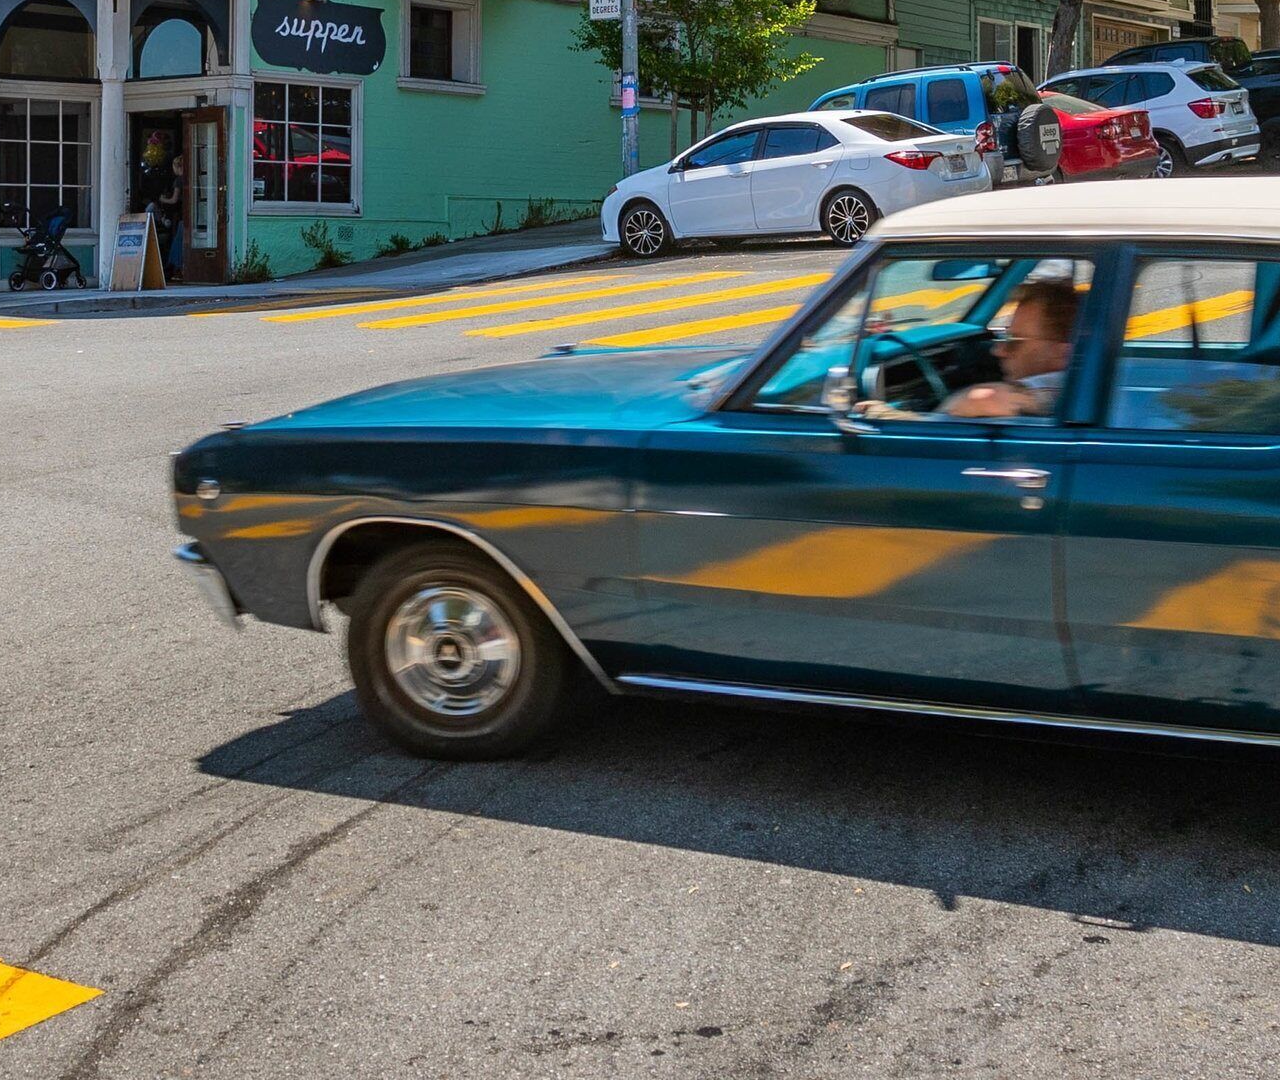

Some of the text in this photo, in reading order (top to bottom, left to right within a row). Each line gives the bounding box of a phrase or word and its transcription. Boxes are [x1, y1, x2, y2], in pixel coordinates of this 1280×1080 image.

[592, 5, 618, 14] DEGREES
[275, 16, 365, 53] supper
[1044, 126, 1056, 138] Jeep
